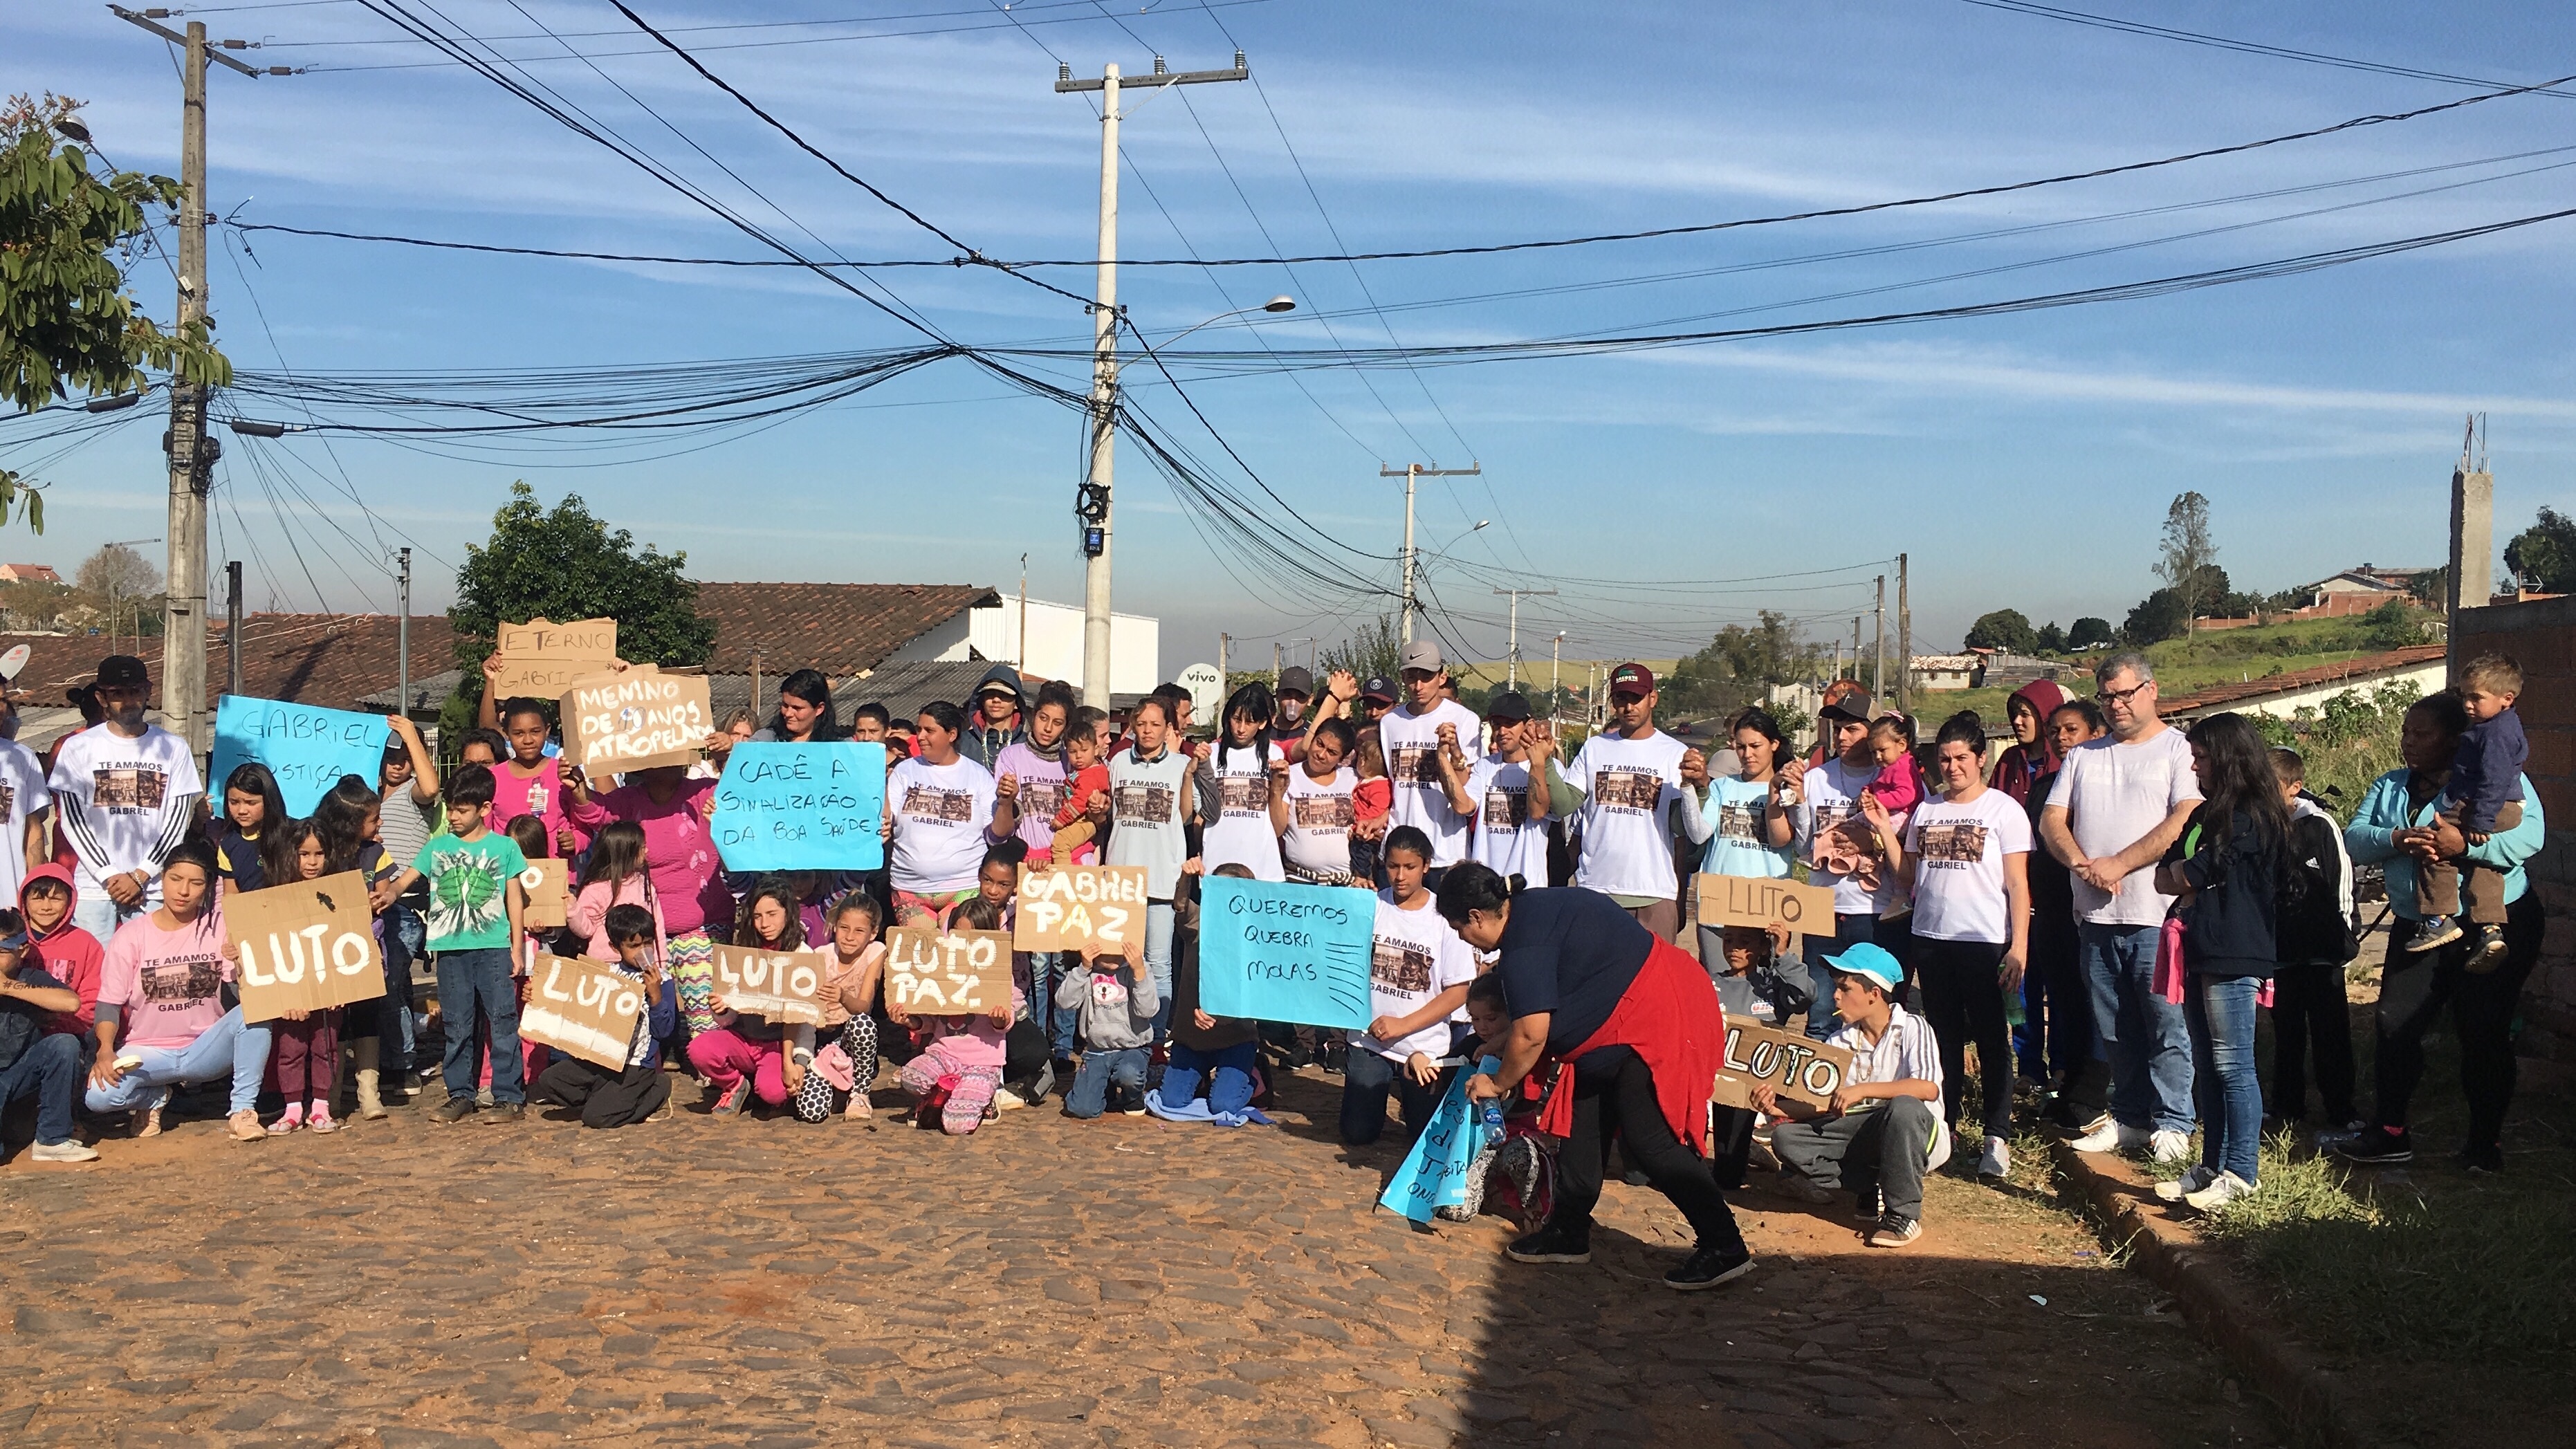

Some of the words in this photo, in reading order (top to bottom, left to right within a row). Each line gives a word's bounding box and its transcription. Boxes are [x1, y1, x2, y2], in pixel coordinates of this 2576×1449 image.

[506, 630, 611, 650] ETERNO
[1187, 672, 1216, 682] vivo
[580, 679, 679, 710] MENINO
[582, 713, 614, 735] DE
[647, 700, 700, 726] ANOS
[115, 762, 163, 771] AMAMOS
[740, 754, 811, 782] CADÊ
[832, 759, 850, 779] A
[1616, 764, 1659, 776] AMAMOS
[927, 785, 967, 795] AMAMOS
[1132, 780, 1170, 789] AMAMOS
[109, 807, 149, 815] GABRIEL
[912, 816, 954, 827] GABRIEL
[1605, 806, 1643, 816] GABRIEL
[724, 826, 755, 845] DA
[773, 821, 807, 841] BOA
[1121, 820, 1158, 829] GABRIEL
[1927, 861, 1967, 869] GABRIEL
[1229, 895, 1347, 925] QUEREMOS
[1729, 878, 1801, 922] LUTO
[1024, 901, 1129, 942] PAZ
[1244, 925, 1313, 948] QUEBRA
[1383, 936, 1431, 954] AMAMOS
[145, 959, 159, 967] TE
[164, 952, 216, 965] AMAMOS
[240, 924, 369, 986] LUTO
[889, 933, 997, 973] LUTO
[720, 950, 816, 997] LUTO
[542, 959, 638, 1018] LUTO
[892, 972, 982, 1008] PAZ
[158, 999, 205, 1012] GABRIEL
[1724, 1028, 1841, 1097] LUTO
